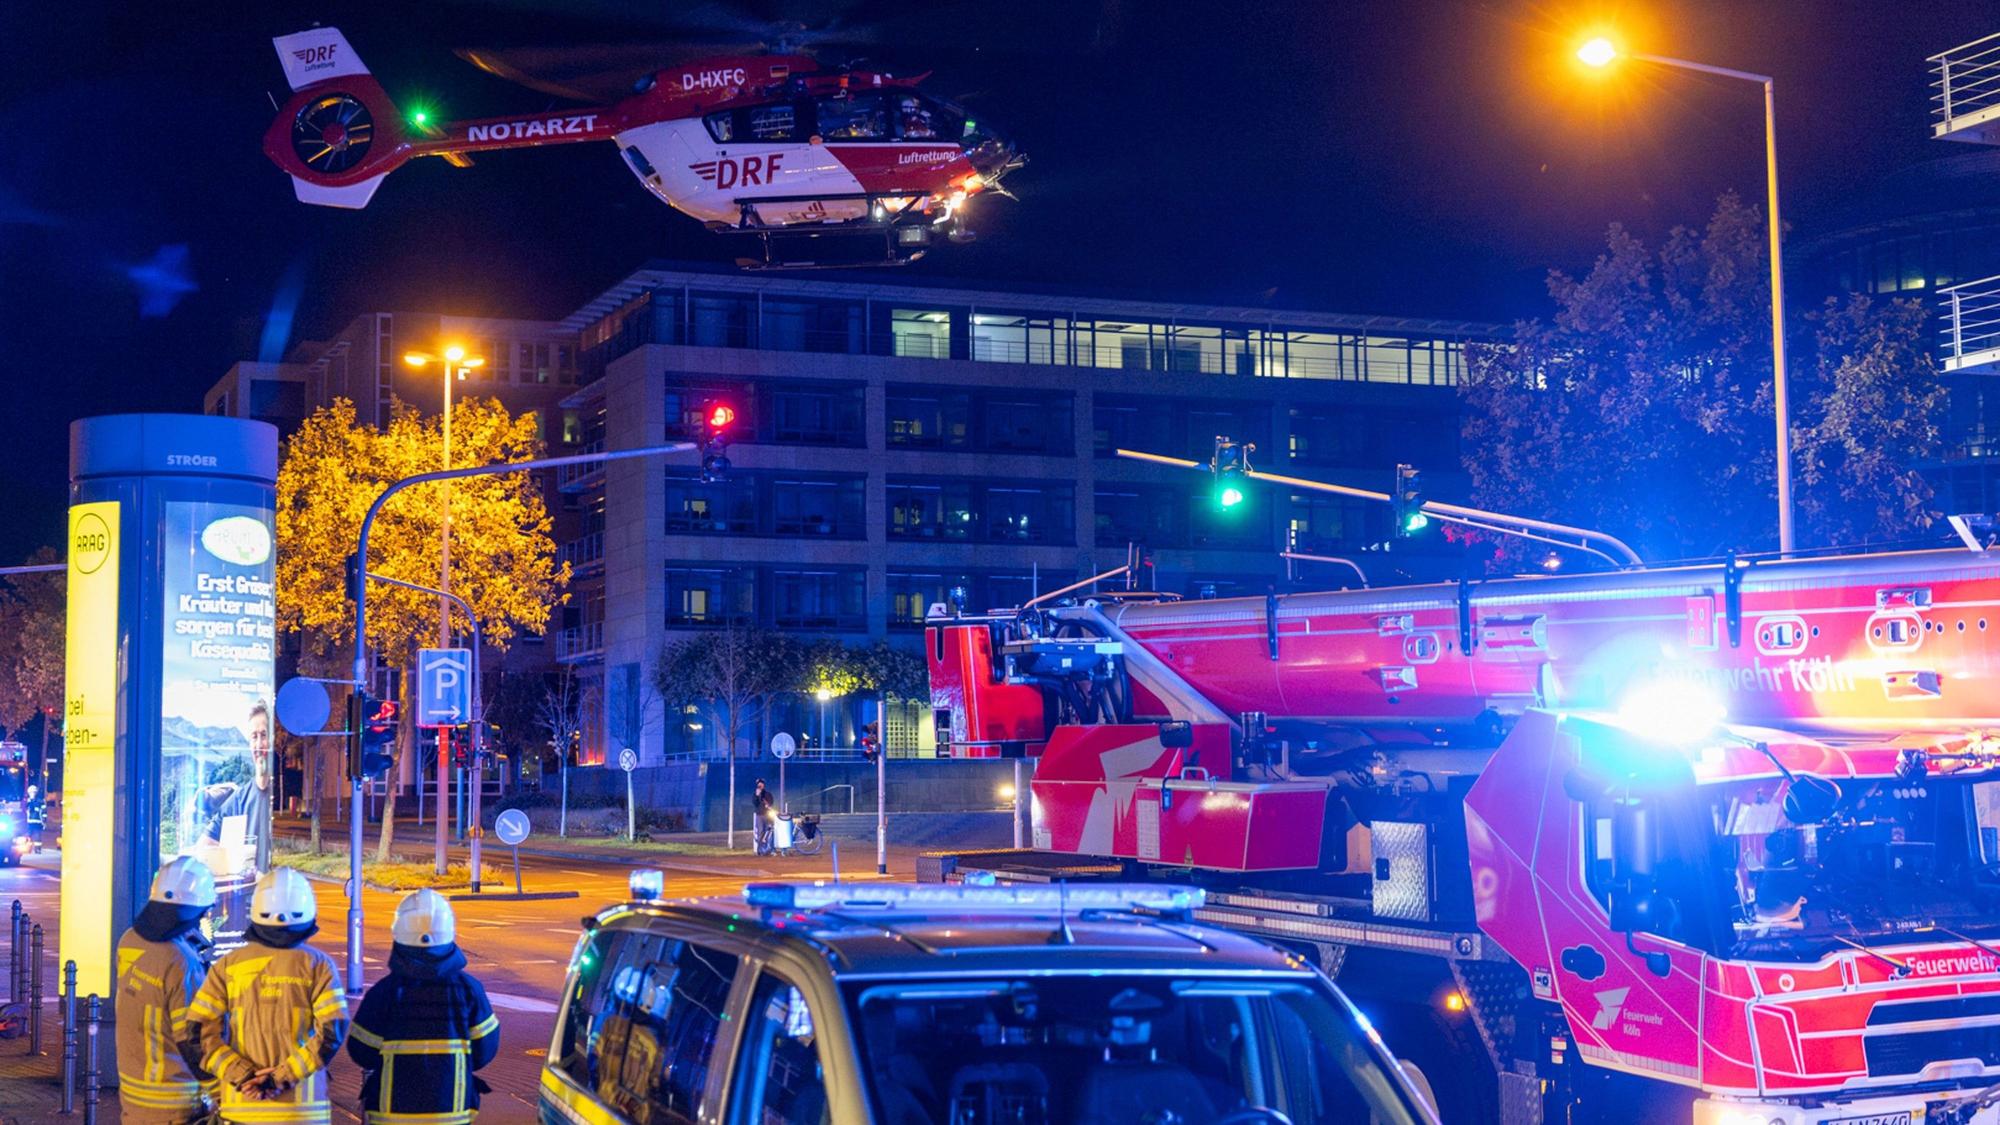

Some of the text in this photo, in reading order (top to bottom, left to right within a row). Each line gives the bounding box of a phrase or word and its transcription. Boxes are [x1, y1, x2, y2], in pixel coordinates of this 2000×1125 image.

[305, 44, 337, 64] DRF
[683, 68, 745, 91] D-HXFC
[468, 115, 598, 142] NOTARZT
[898, 149, 957, 165] Luftrettung
[717, 153, 784, 190] DRF
[75, 534, 105, 552] ARAG
[197, 573, 234, 593] Erst
[180, 593, 242, 615] Kräuter
[175, 620, 234, 639] sorgen
[436, 668, 458, 699] P
[1789, 655, 1857, 692] Köln
[1906, 950, 1996, 976] Feuerwehr
[1623, 1007, 1663, 1026] Feuerwehr
[1623, 1023, 1641, 1037] Köln
